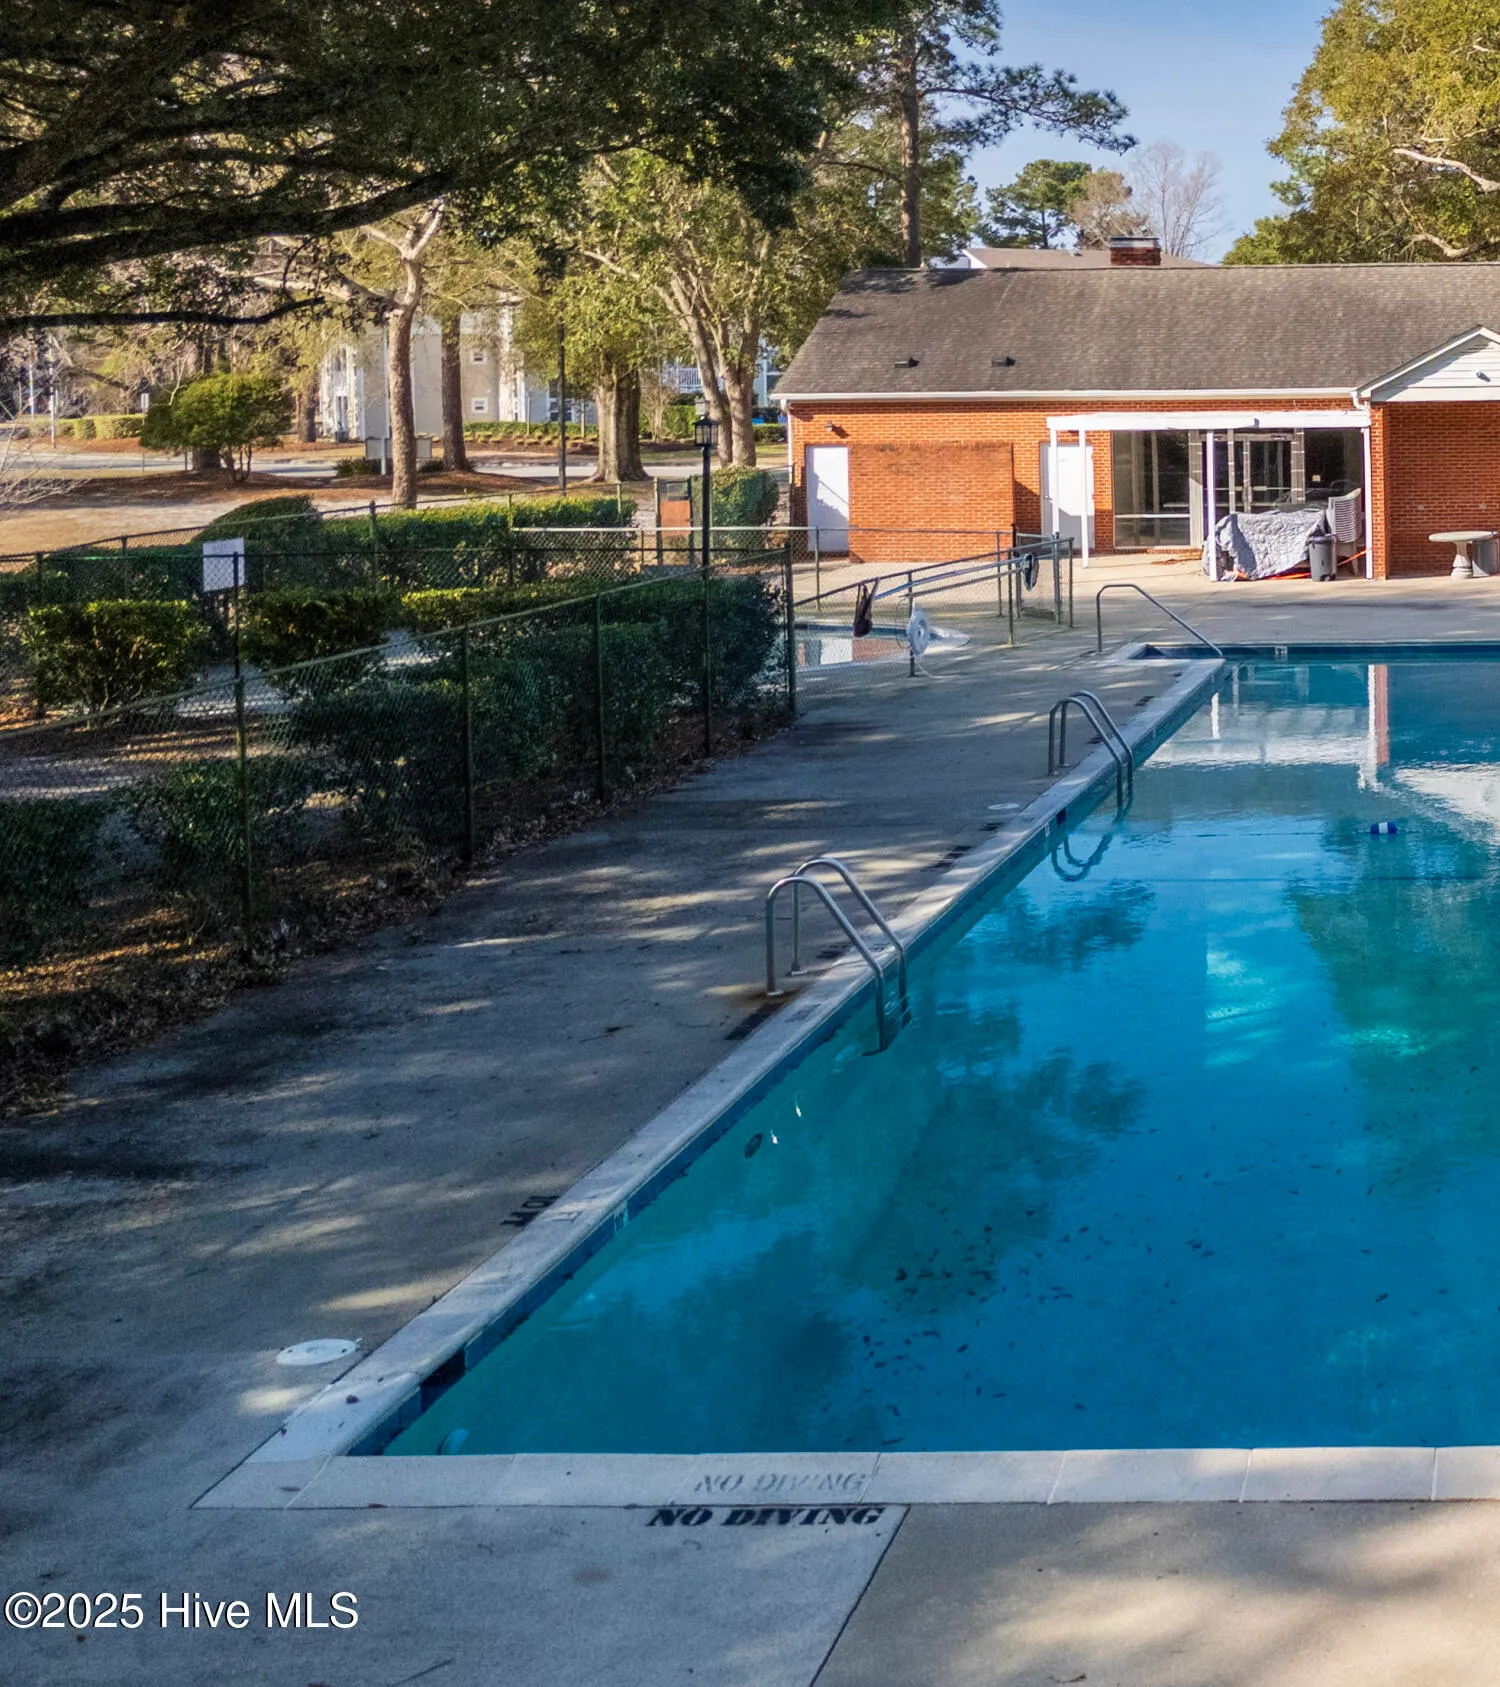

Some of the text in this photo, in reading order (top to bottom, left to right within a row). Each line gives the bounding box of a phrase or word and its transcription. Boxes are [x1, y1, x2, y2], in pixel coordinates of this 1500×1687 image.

[694, 1475, 744, 1494] NO
[647, 1506, 885, 1527] NO DIVING
